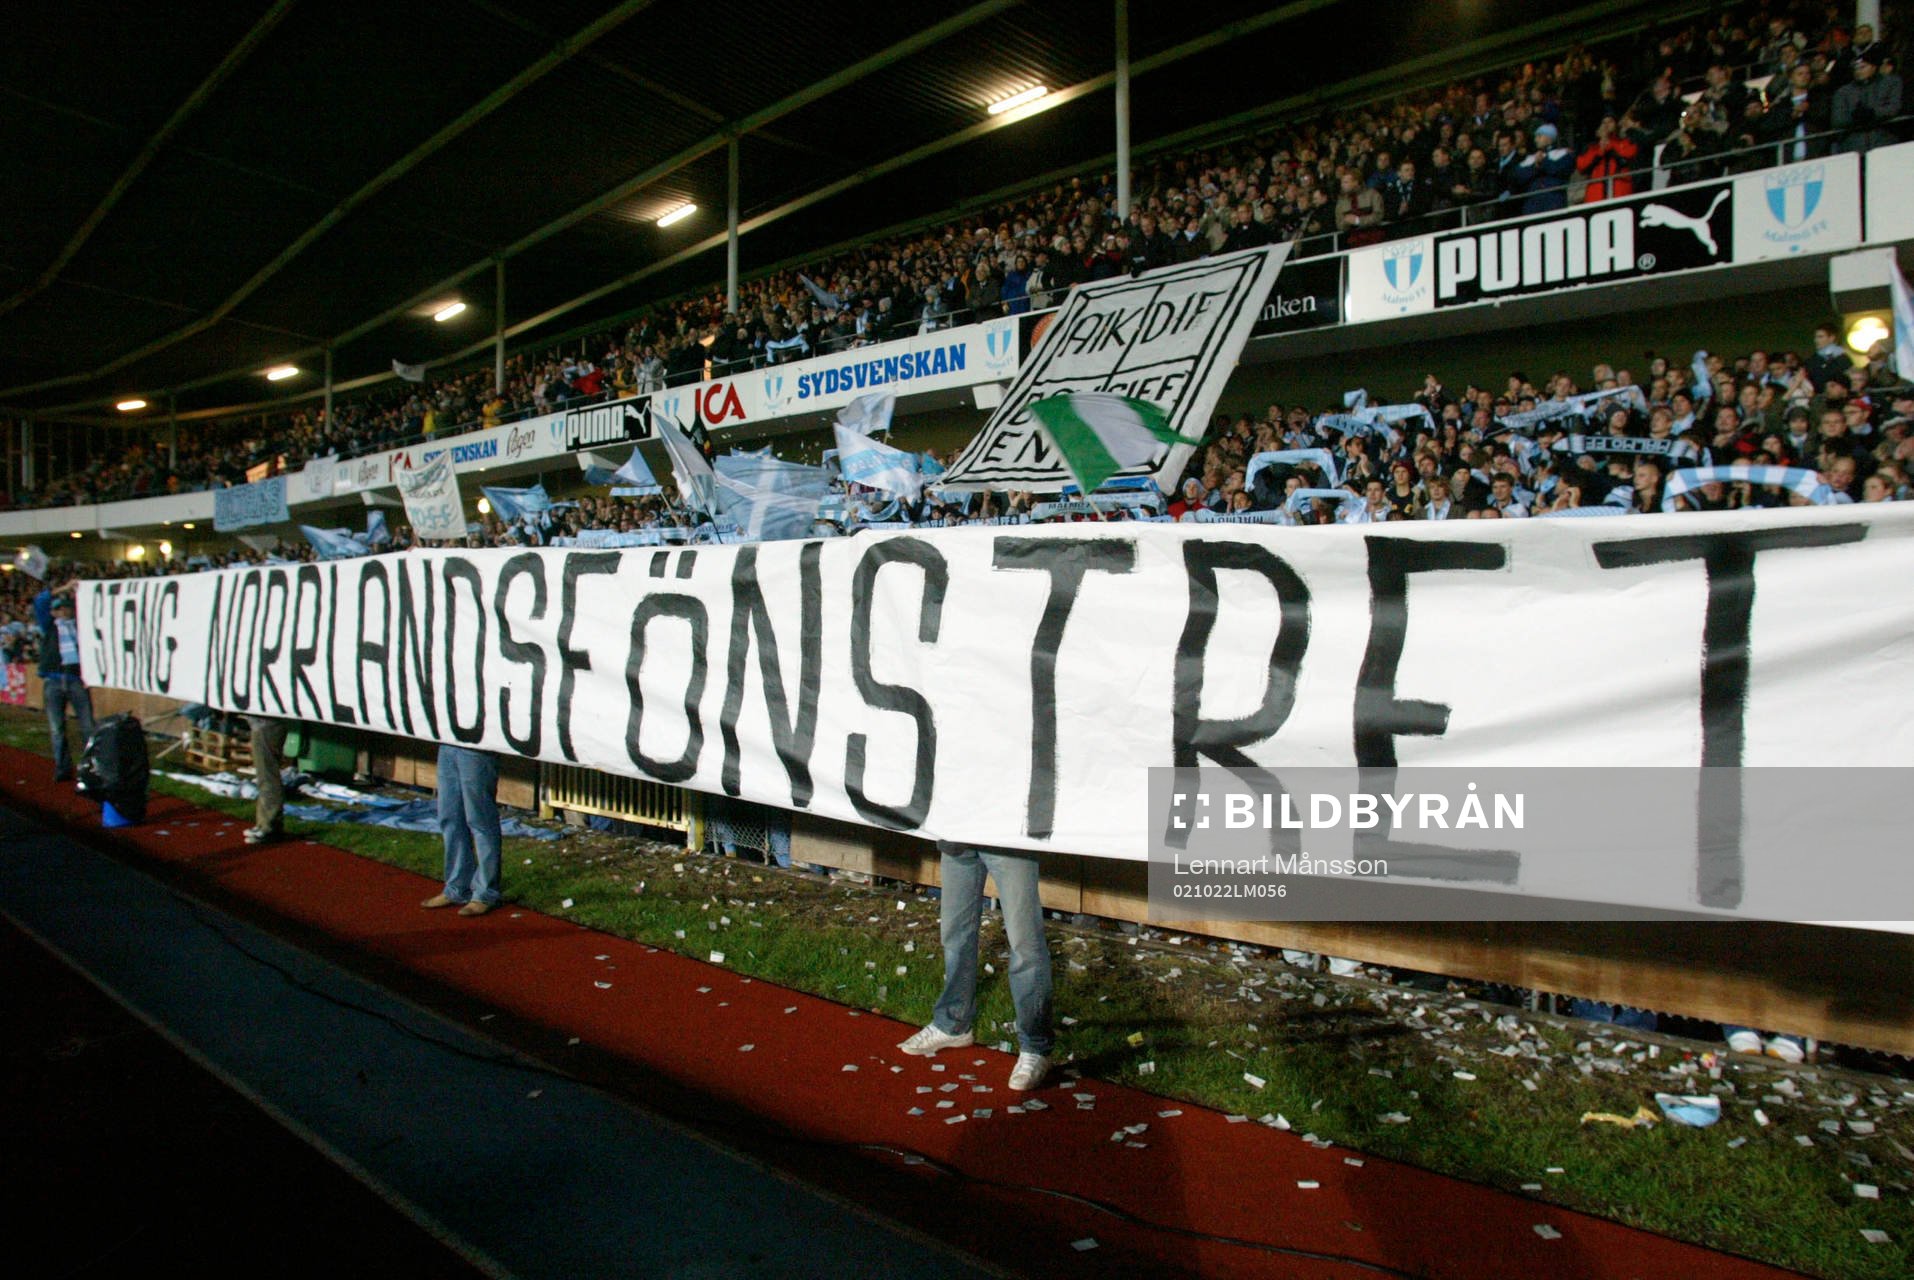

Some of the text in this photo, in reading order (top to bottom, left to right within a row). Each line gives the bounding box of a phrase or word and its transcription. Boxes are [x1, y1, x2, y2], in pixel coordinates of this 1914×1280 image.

[1438, 207, 1635, 300] PUMA
[1057, 289, 1229, 358] AIK DIF
[1260, 294, 1317, 321] nken
[797, 342, 967, 399] SYDSVENSKAN
[567, 405, 624, 447] PUMA
[694, 381, 747, 425] ICA
[92, 521, 1870, 910] STÄNG NORRLANDSFÖNSTRET
